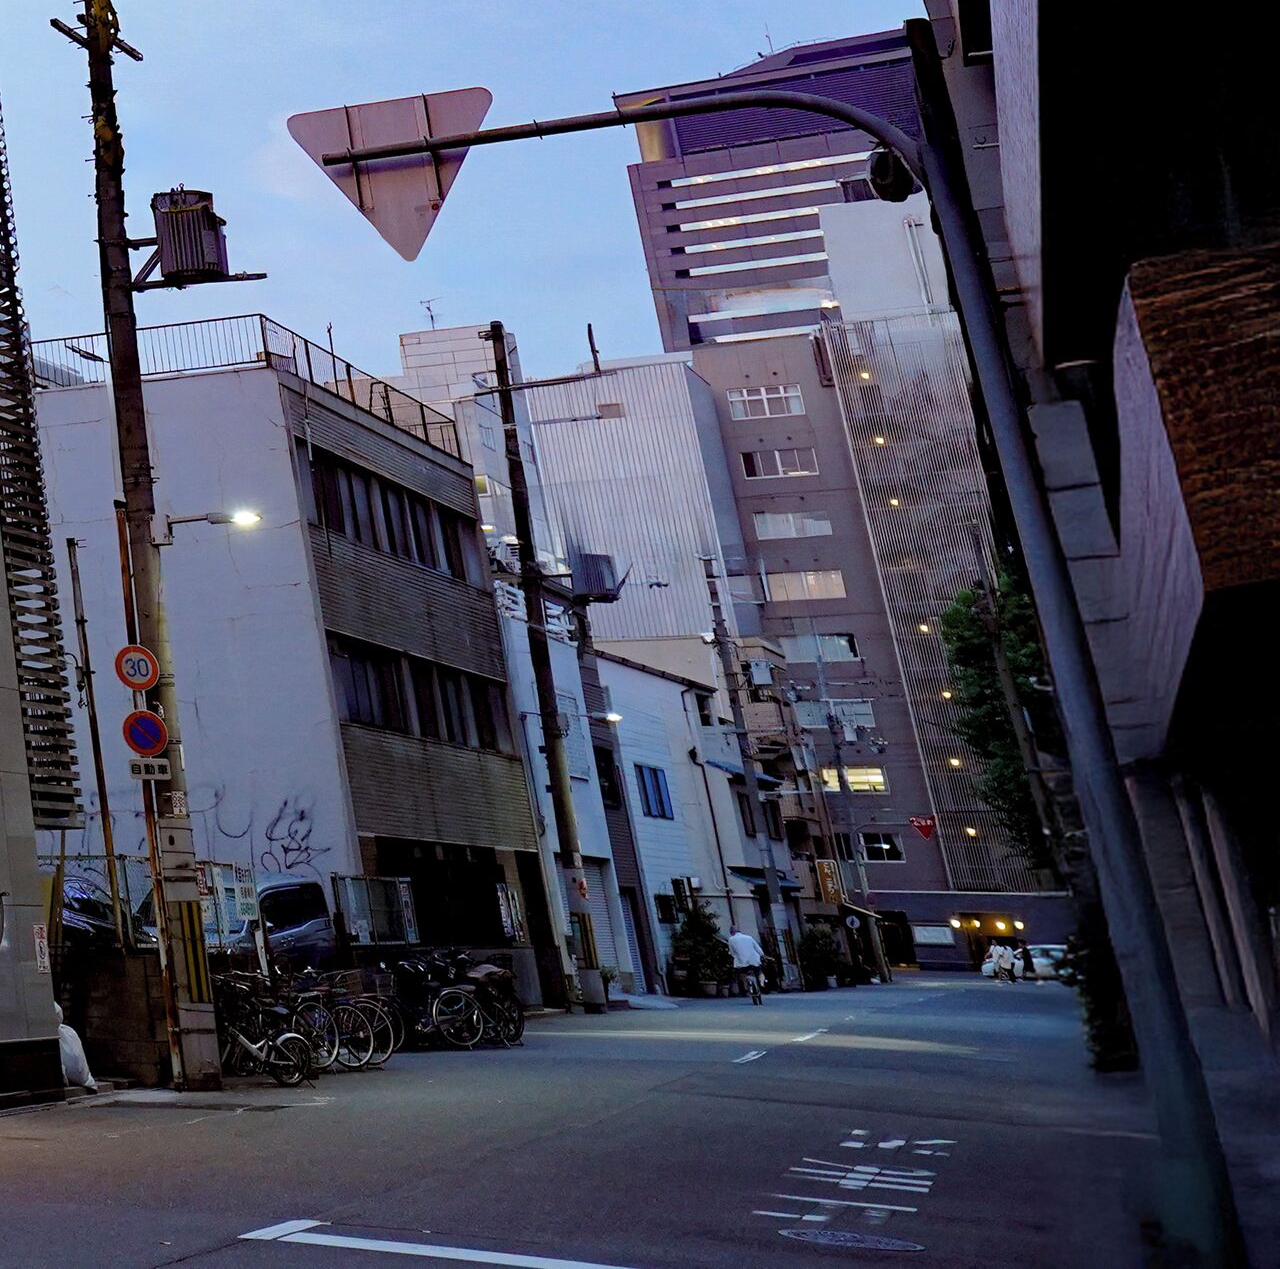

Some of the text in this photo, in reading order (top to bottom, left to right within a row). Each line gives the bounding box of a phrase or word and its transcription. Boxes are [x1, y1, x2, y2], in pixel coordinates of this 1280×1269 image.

[125, 657, 150, 678] 30
[131, 762, 169, 776] 自動車
